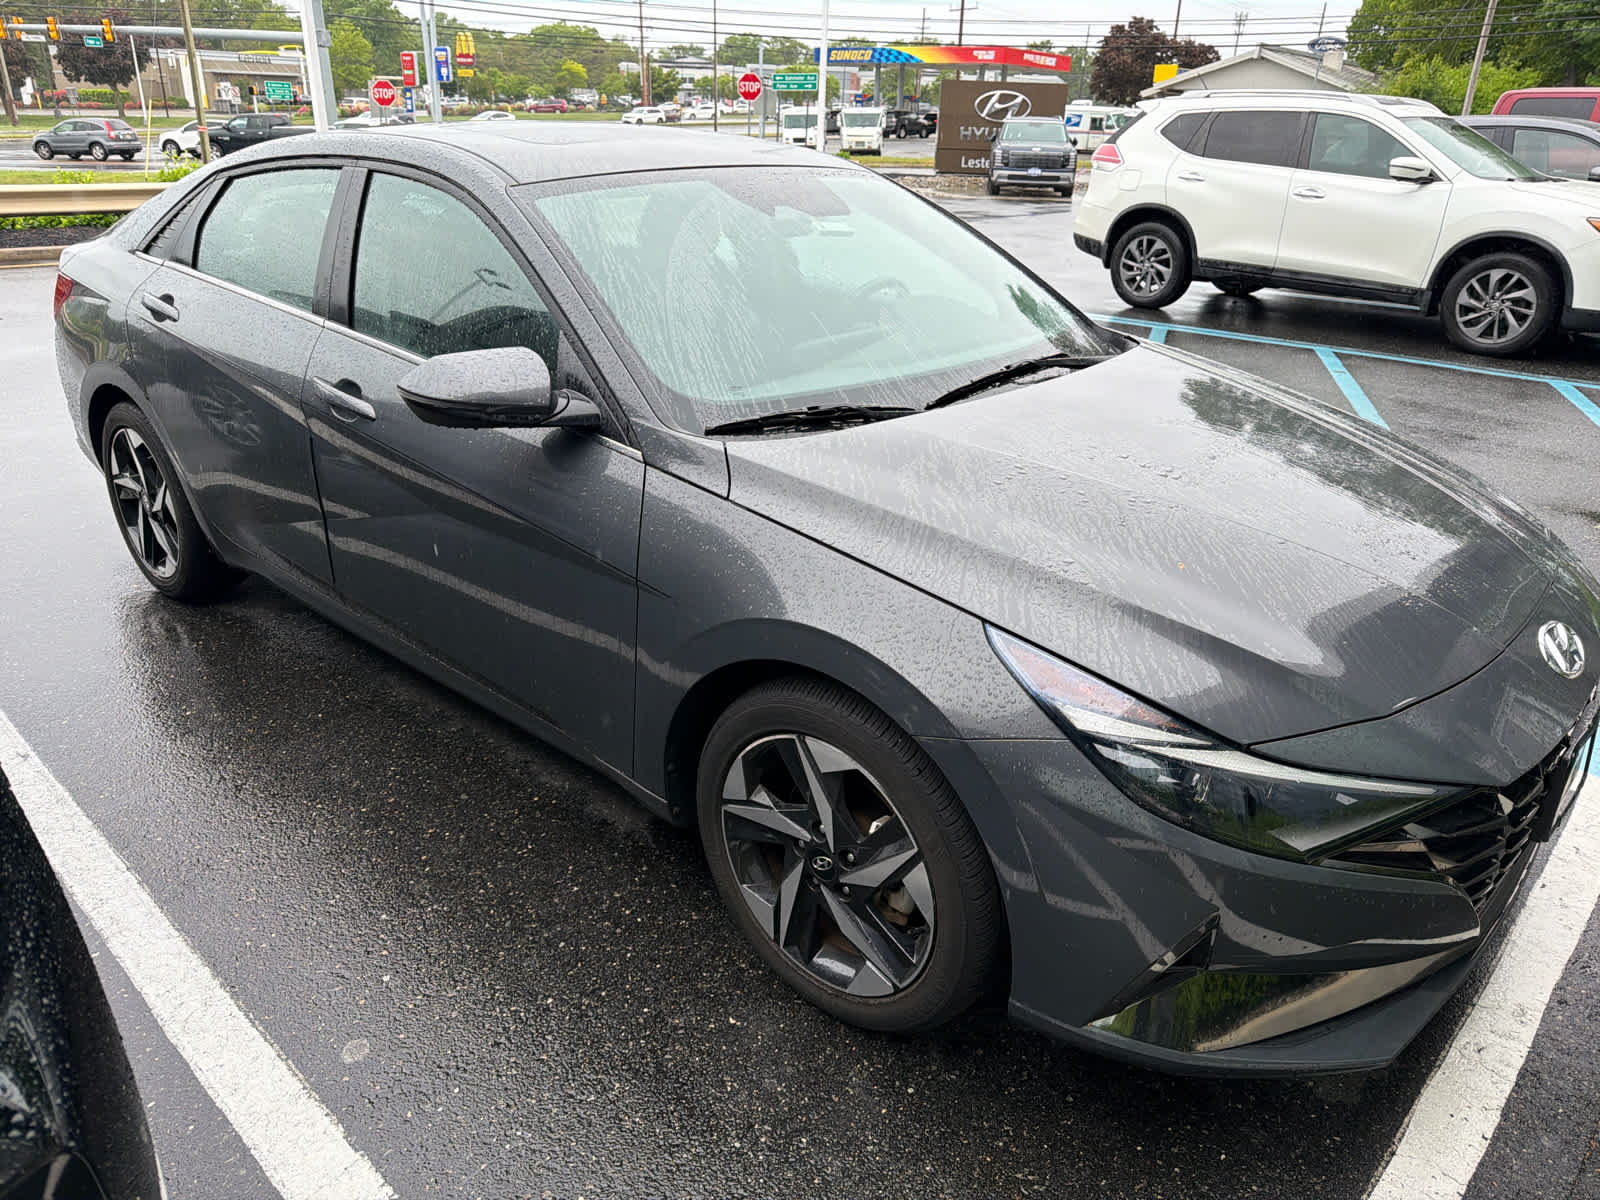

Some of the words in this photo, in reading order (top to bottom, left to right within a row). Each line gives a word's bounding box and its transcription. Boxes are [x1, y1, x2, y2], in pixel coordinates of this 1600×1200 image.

[829, 50, 872, 61] SUNOCO
[739, 81, 760, 93] STOP
[374, 88, 393, 99] STOP
[960, 126, 1001, 142] HYU
